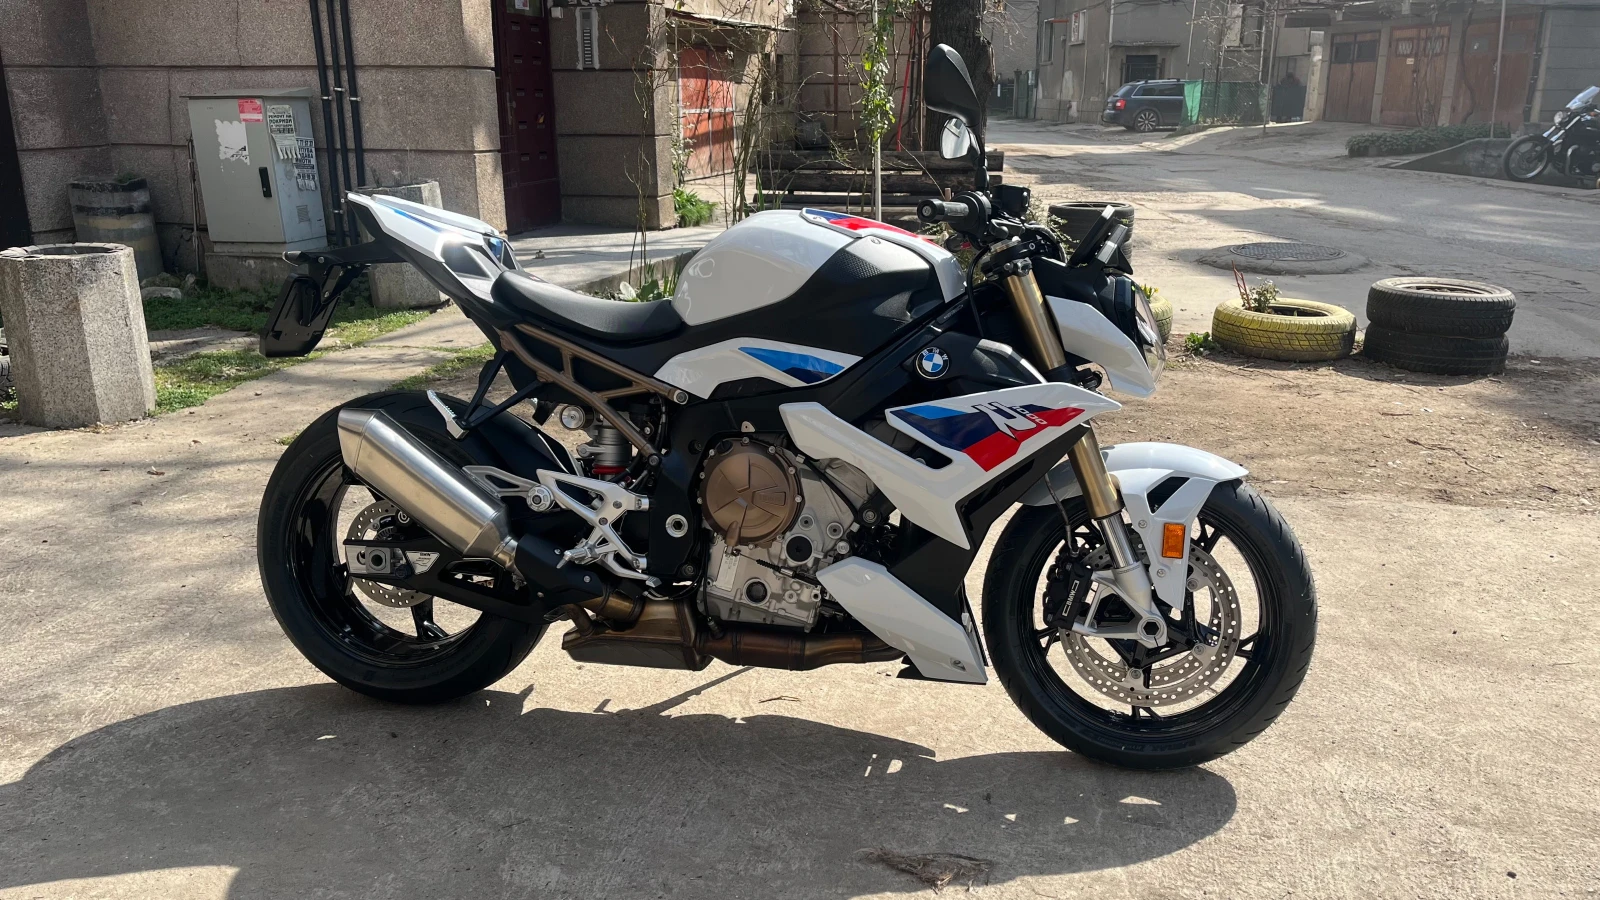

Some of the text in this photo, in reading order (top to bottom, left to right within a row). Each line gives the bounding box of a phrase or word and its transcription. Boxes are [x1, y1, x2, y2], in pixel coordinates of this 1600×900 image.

[921, 347, 949, 361] BMW
[969, 401, 1048, 441] R 1000
[1066, 589, 1076, 605] BMW
